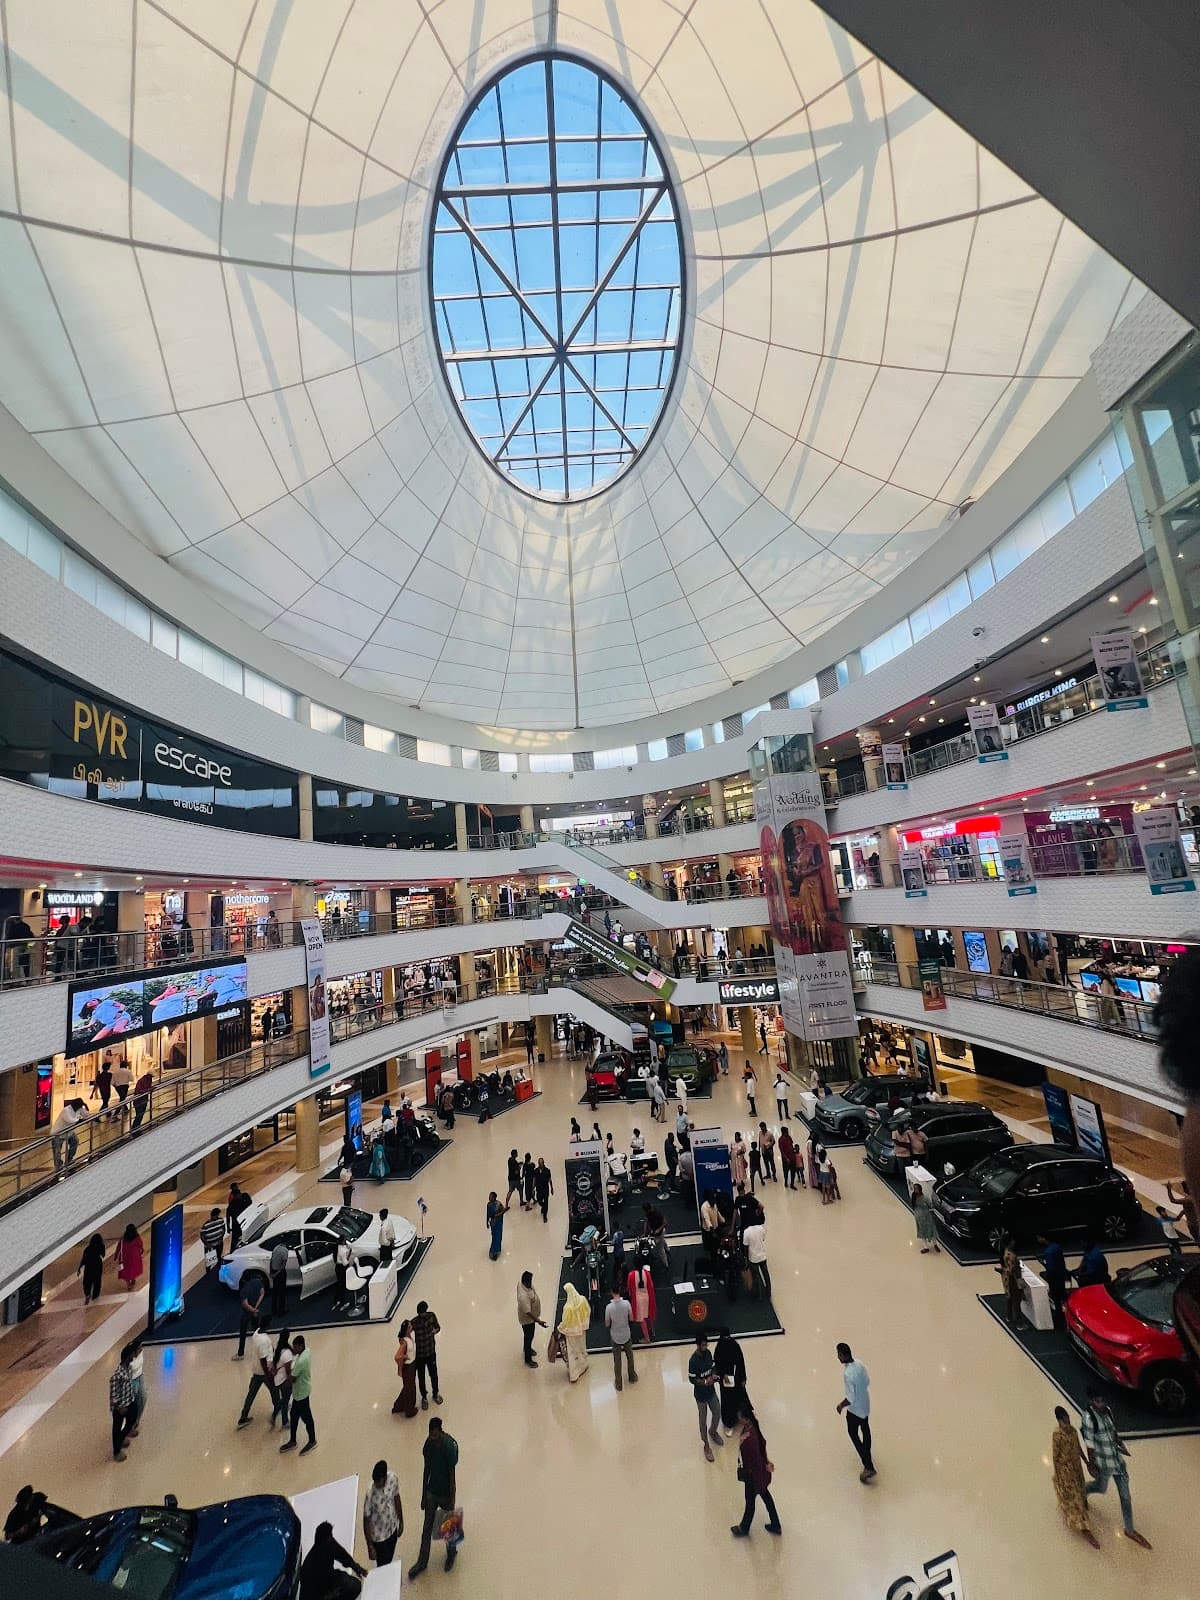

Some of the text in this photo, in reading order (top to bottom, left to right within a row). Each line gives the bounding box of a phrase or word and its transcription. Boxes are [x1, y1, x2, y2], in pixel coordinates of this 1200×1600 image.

[1017, 678, 1077, 711] BURGER KING
[73, 701, 128, 760] PVR
[154, 743, 232, 786] escape
[776, 789, 821, 806] Wedding
[1042, 832, 1066, 845] LAVIE
[48, 893, 94, 904] WOODLAND
[800, 970, 849, 982] AVANTRA
[721, 983, 775, 999] lifestyle
[826, 1000, 848, 1008] FLOOR
